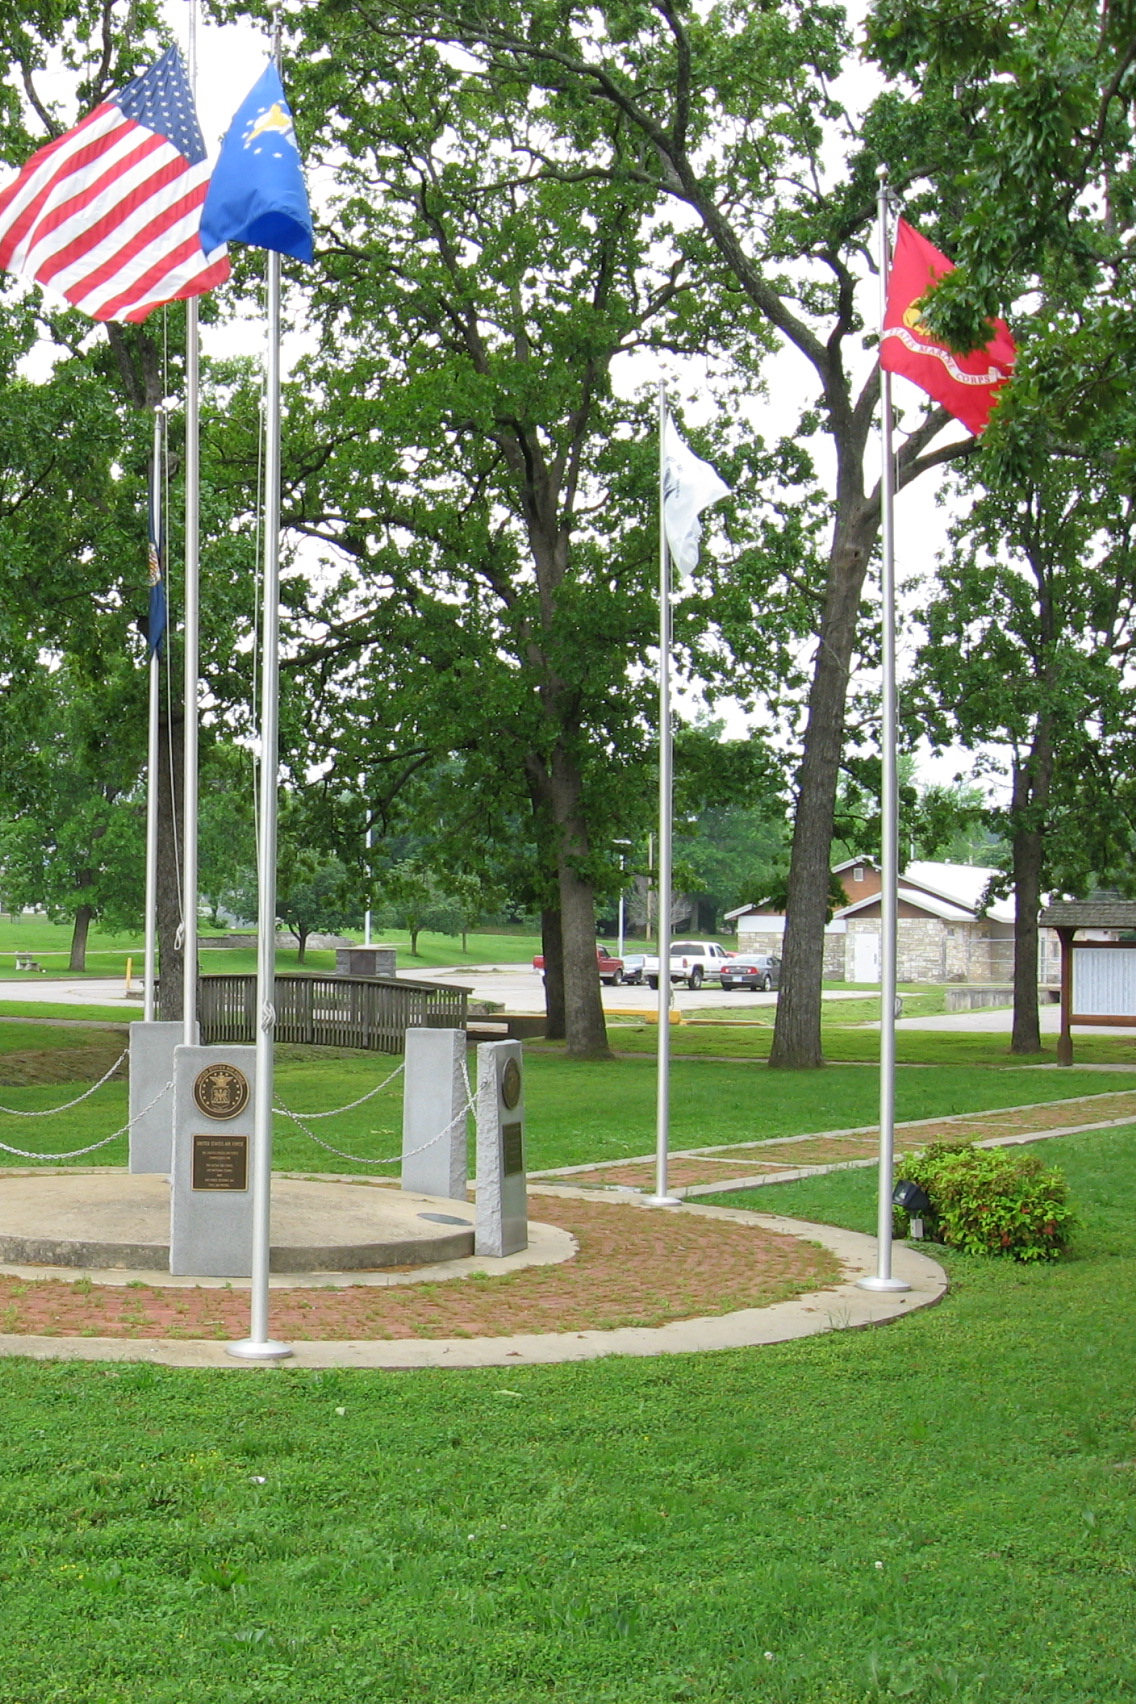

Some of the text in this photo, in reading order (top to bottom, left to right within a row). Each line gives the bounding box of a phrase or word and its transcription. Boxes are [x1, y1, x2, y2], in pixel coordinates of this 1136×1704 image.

[889, 328, 991, 384] STATES MARINE CORPS
